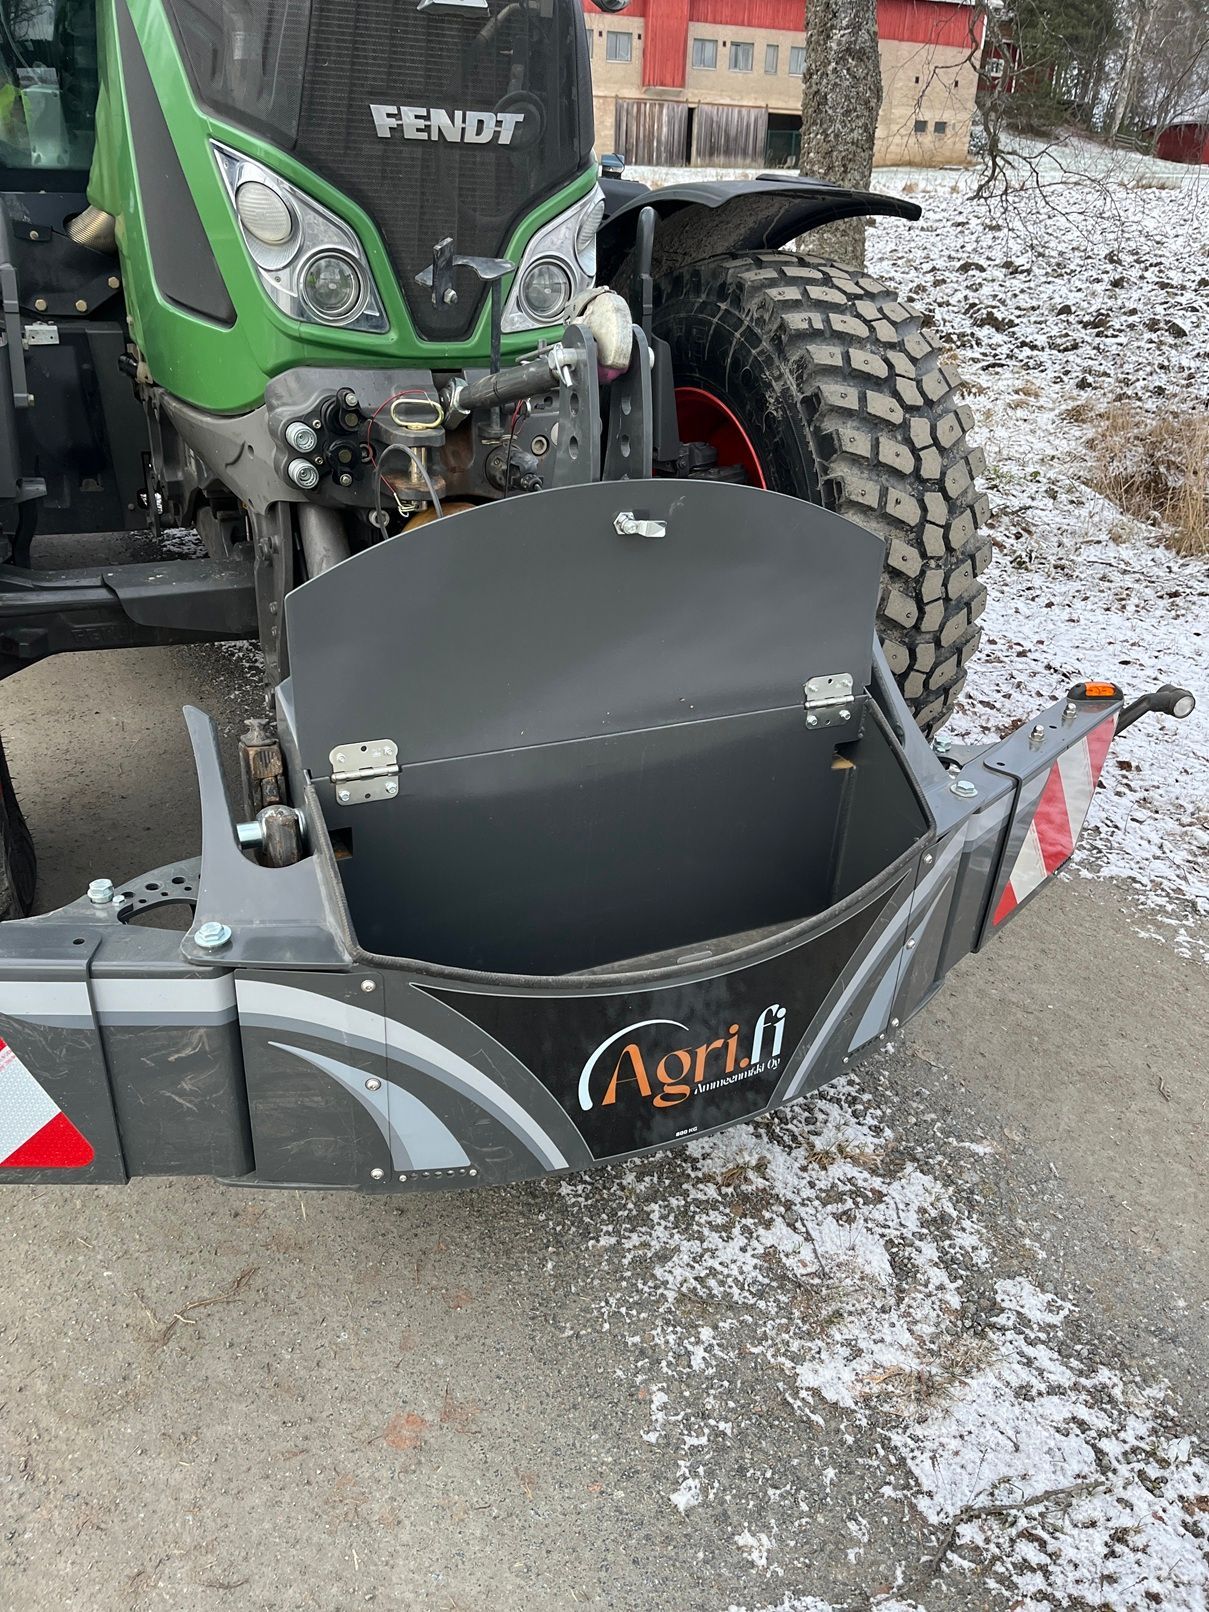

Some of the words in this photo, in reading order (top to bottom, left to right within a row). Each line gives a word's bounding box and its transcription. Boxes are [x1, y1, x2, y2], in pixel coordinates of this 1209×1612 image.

[369, 104, 525, 145] FENDT
[601, 1003, 787, 1108] Agri.fi
[766, 1058, 781, 1070] Oy
